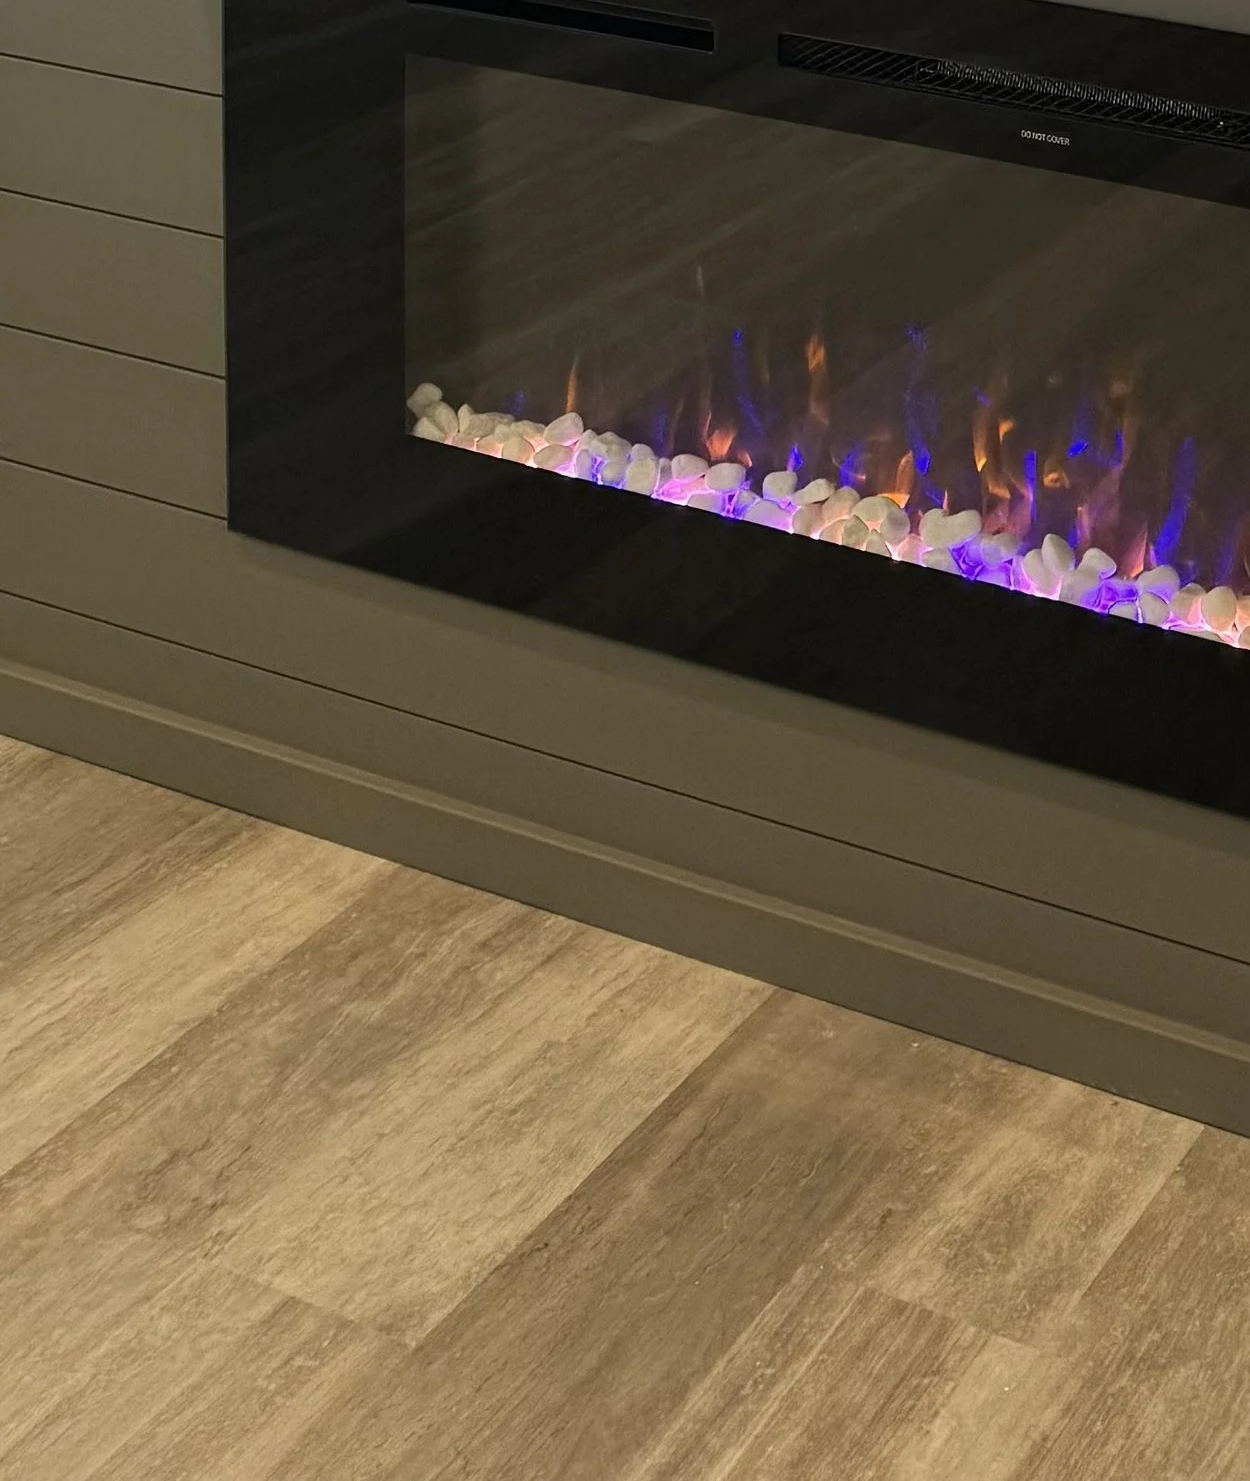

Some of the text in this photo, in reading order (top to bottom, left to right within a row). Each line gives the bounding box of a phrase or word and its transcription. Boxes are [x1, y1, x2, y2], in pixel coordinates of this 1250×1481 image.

[1020, 129, 1070, 146] DO NOT COVER
